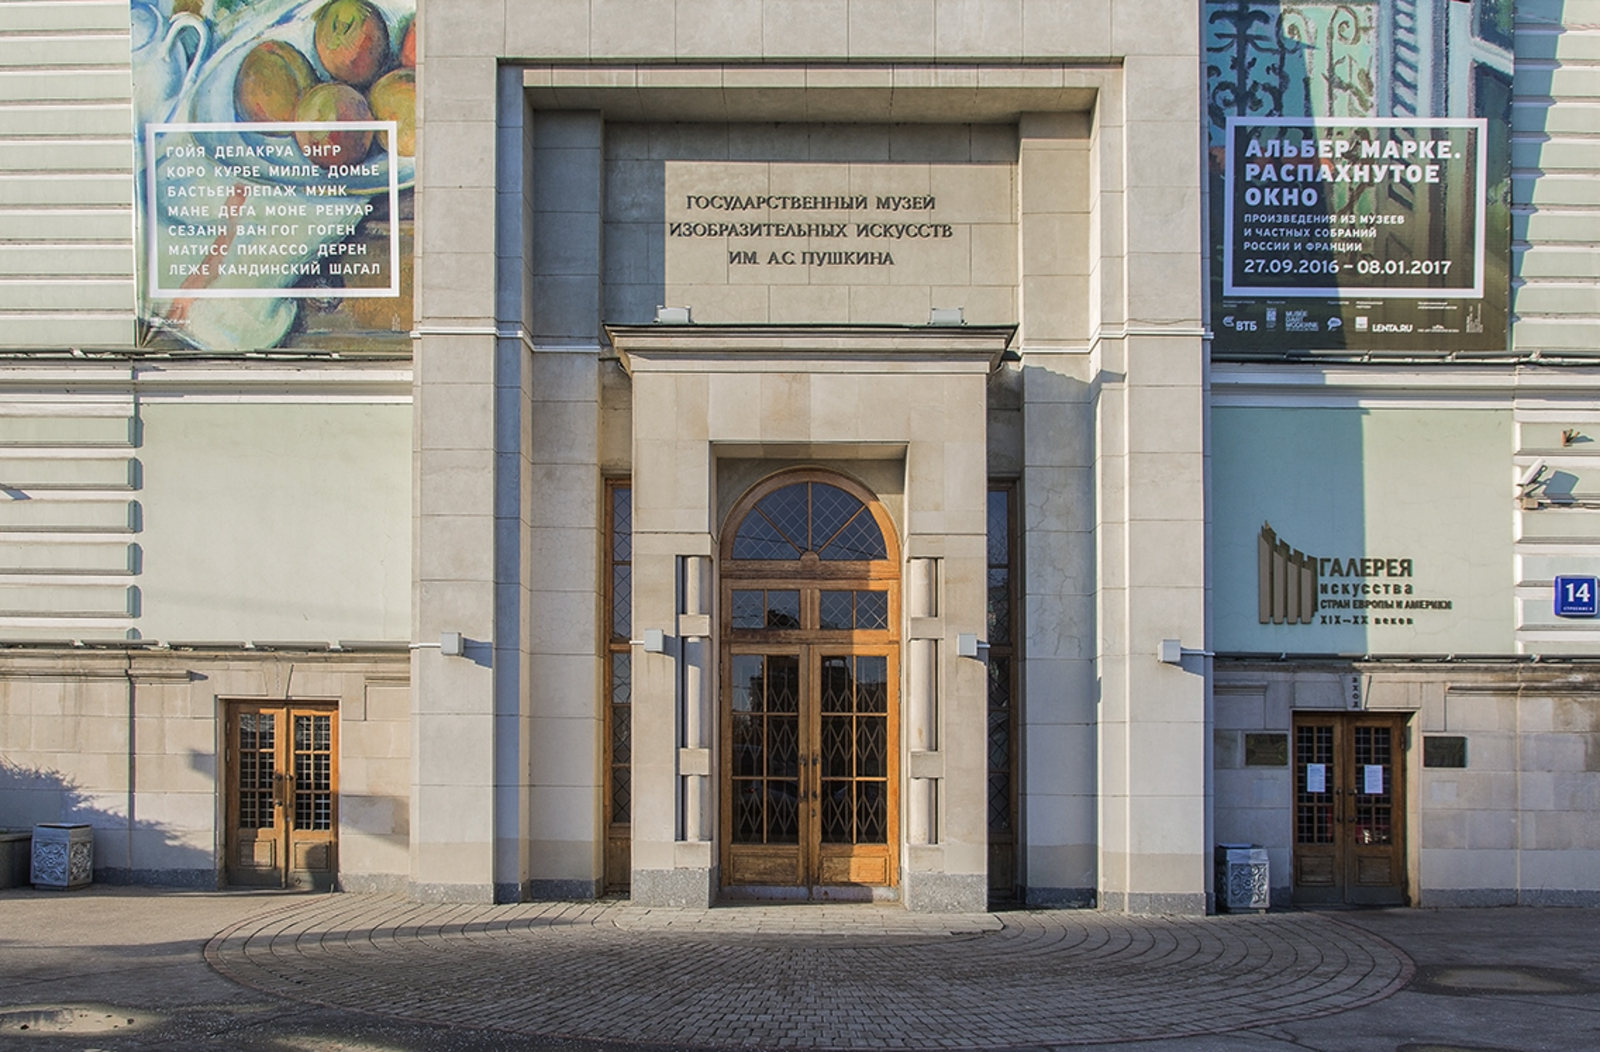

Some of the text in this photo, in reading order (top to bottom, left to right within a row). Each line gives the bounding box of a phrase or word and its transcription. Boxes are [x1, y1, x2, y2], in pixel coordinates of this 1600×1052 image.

[166, 144, 341, 158] ГОЙЯ ДЕЛАКРУА ЭНГР
[1245, 140, 1461, 159] АЛЬБЕР МАРКЕ.
[166, 165, 379, 178] КОРО КУРБЕ МИЛЛЕ ДОМЬЕ
[1245, 164, 1440, 182] РАСПАХНУТОЕ
[167, 185, 347, 197] БАСТЬЕН-ЛЕПАЖ МУНК
[1245, 188, 1318, 206] ОКНО
[686, 195, 936, 211] ГОСУДАРСТВЕННЫЙ МУЗЕЙ
[168, 204, 374, 217] МАНЕ ДЕГА МОНЕ РЕНУАР
[1244, 214, 1404, 225] ПРОИЗВЕДЕНИЯ ИЗ МУЗЕЕВ
[168, 224, 356, 236] СЕЗАНН ВАН ГОГ ГОГЕН
[669, 223, 952, 238] ИЗОБРАЗИТЕЛЬНЫХ ИСКУССТВ
[1244, 227, 1376, 238] И ЧАСТНЫХ СОБРАНИЙ
[169, 244, 367, 256] МАТИСС ПИКАССО ДЕРЕН
[1244, 242, 1362, 252] РОССИИ И ФРАНЦИИ
[801, 251, 894, 266] ПУШКИНА
[169, 261, 380, 276] ЛЕЖЕ КАНДИНСКИЙ ШАГАЛ
[1244, 260, 1339, 274] 27.09.2016
[1357, 261, 1452, 274] 08.01.2017
[1236, 321, 1257, 331] ВТБ
[1372, 324, 1413, 332] LENTA.RU
[1319, 558, 1413, 577] ГАЛЕРЕЯ
[1566, 583, 1590, 602] 14
[1320, 600, 1452, 610] СТРАН ЕВРОПЫ И АМЕРИКИ
